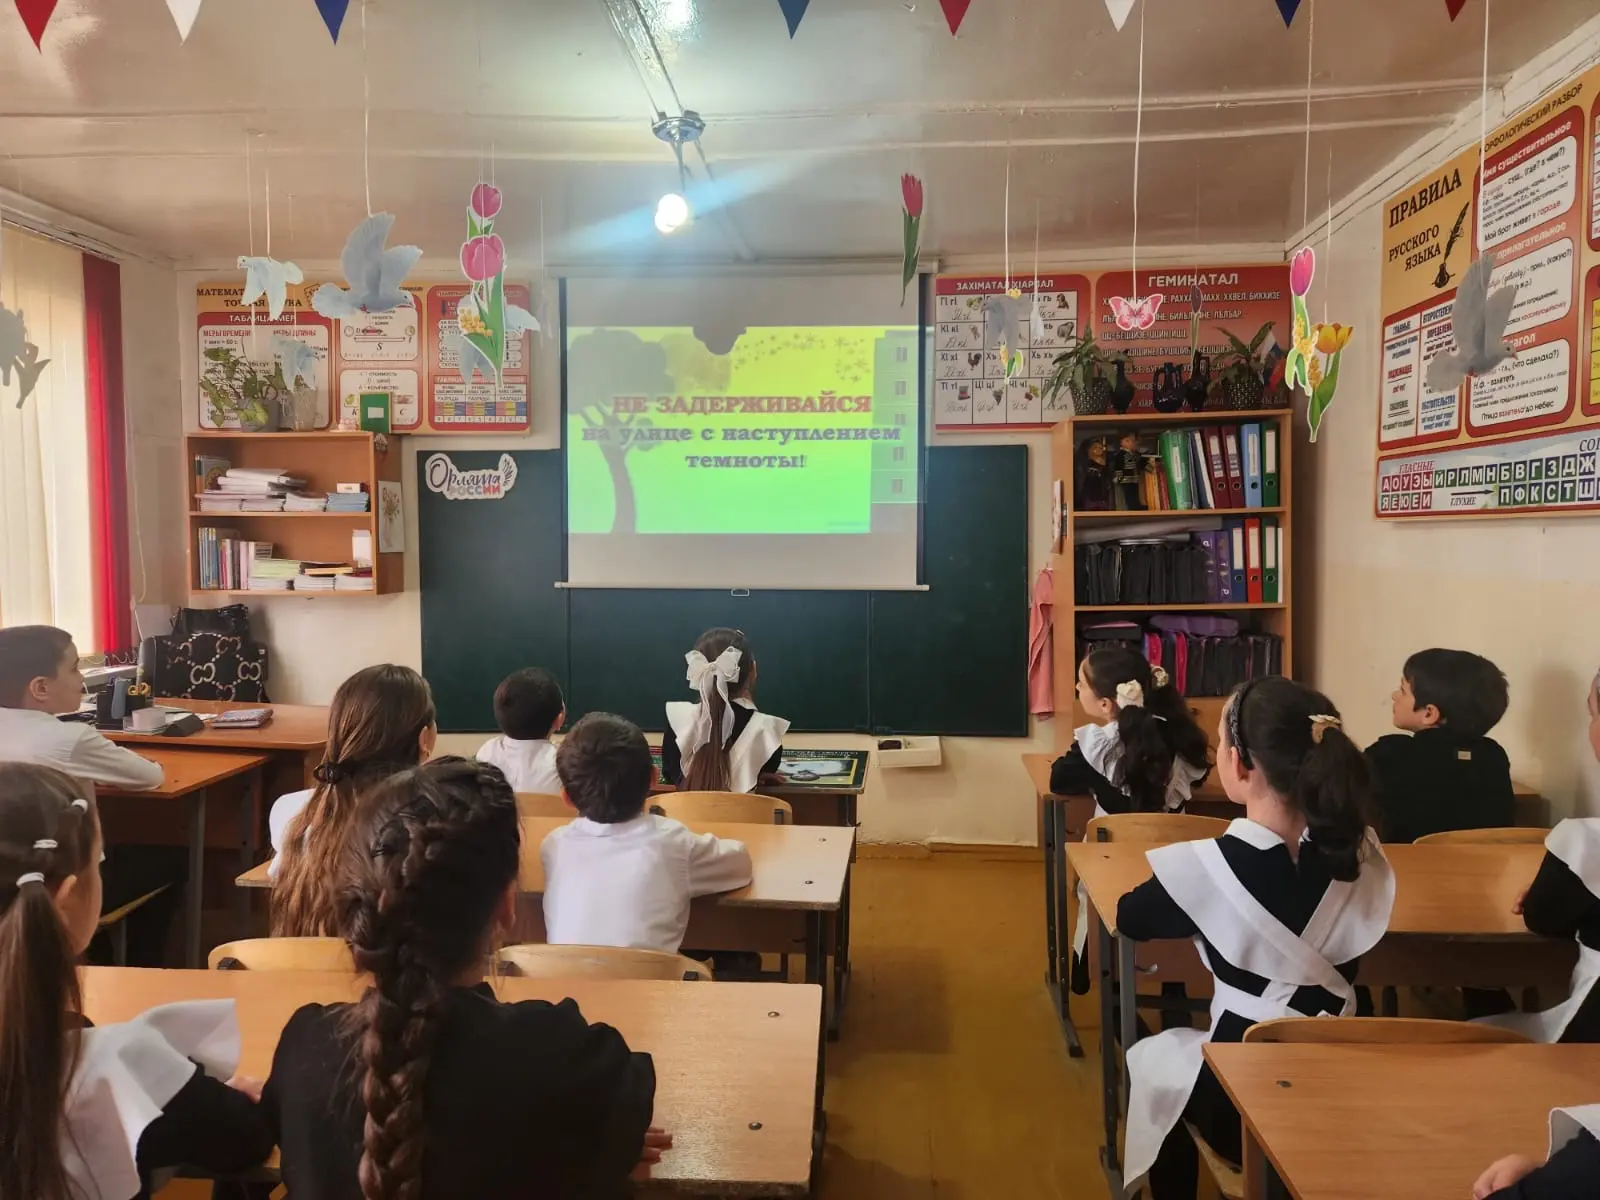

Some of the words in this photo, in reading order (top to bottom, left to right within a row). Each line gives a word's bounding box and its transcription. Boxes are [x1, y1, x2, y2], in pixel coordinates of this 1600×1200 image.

[1552, 84, 1582, 110] РАЗБОР
[1498, 121, 1572, 170] существительное
[1389, 168, 1462, 228] ПРАВИЛА
[1389, 224, 1439, 261] РУССКОГО
[1484, 230, 1496, 240] Мой
[1405, 242, 1441, 271] ЯЗЫКА
[1149, 274, 1238, 287] ГЕМИНАТАЛ
[1423, 304, 1452, 323] ВТОРОСТЕПЕН
[613, 396, 647, 414] НЕ
[656, 390, 872, 415] ЗАДЕРЖИВАЙСЯ
[1482, 411, 1497, 420] Птица
[1535, 400, 1554, 410] небес
[582, 427, 616, 441] на
[619, 427, 693, 445] улице
[701, 428, 714, 441] с
[722, 426, 901, 445] наступлением
[685, 452, 806, 468] темноты!
[1400, 461, 1434, 473] ГЛАСНЫЕ
[430, 458, 501, 491] Орлята
[450, 485, 500, 496] РОССИИ
[1450, 497, 1476, 506] ГЛУХИЕ
